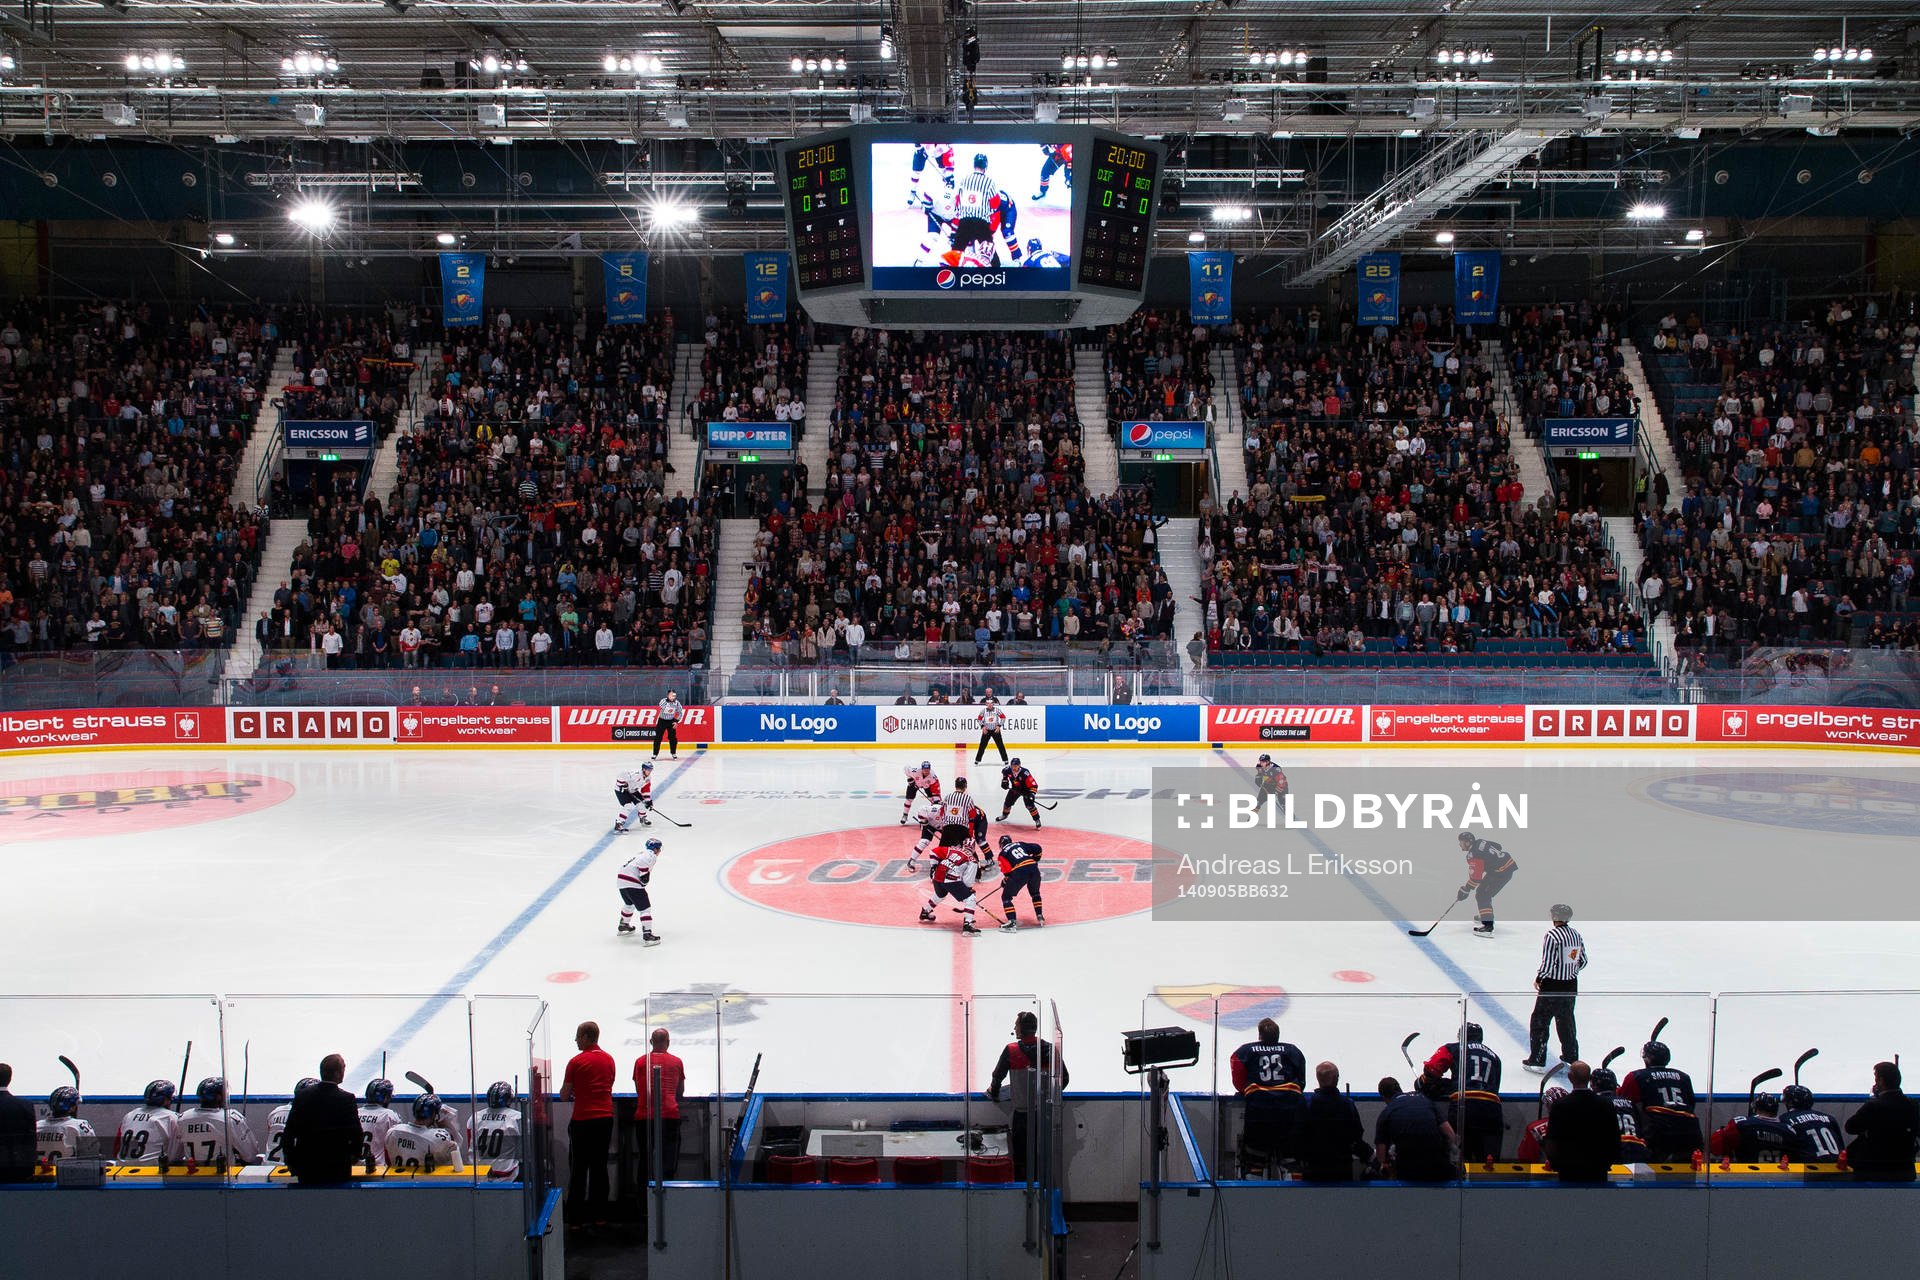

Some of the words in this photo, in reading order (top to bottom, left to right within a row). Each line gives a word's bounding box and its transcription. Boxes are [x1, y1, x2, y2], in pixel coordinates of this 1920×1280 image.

[799, 145, 835, 168] 20:00
[1108, 146, 1146, 169] 20:00
[1097, 168, 1114, 182] DIF
[793, 176, 808, 190] DIF
[803, 195, 811, 211] 0
[840, 187, 848, 205] 0
[1103, 190, 1112, 207] 0
[1139, 198, 1148, 215] 0
[456, 266, 470, 278] 2
[755, 263, 778, 275] 12
[1202, 264, 1223, 276] 11
[1365, 265, 1391, 277] 25
[1472, 266, 1484, 277] 2
[960, 271, 1006, 287] pepsi
[290, 429, 348, 439] ERICSSON
[1154, 428, 1192, 442] pepsi
[1551, 427, 1609, 437] ERICSSON
[423, 715, 491, 727] engelbert
[495, 716, 550, 725] strauss
[567, 709, 706, 725] WARRR
[1215, 708, 1354, 724] WARRIOR
[1396, 713, 1464, 725] engelbert
[1468, 715, 1524, 724] strauss
[1538, 715, 1682, 731] CRAMO
[1756, 711, 1873, 728] engelbert
[0, 716, 64, 732] lbert
[72, 715, 166, 729] strauss
[239, 717, 383, 733] CRAMO
[760, 713, 787, 730] No
[791, 713, 838, 734] Logo
[900, 718, 957, 731] CHAMPIONS
[1002, 718, 1038, 731] LEAGUE
[1084, 713, 1111, 730] No
[1115, 713, 1161, 734] Logo
[1430, 725, 1490, 734] workwear
[16, 732, 98, 744] workwear
[457, 727, 517, 735] workwear
[1825, 730, 1908, 741] workwear
[1259, 1054, 1285, 1082] 32
[1470, 1055, 1492, 1083] 17
[133, 1113, 152, 1121] FOY
[188, 1123, 211, 1133] BELL
[398, 1138, 416, 1150] POHL
[1806, 1127, 1839, 1157] 10
